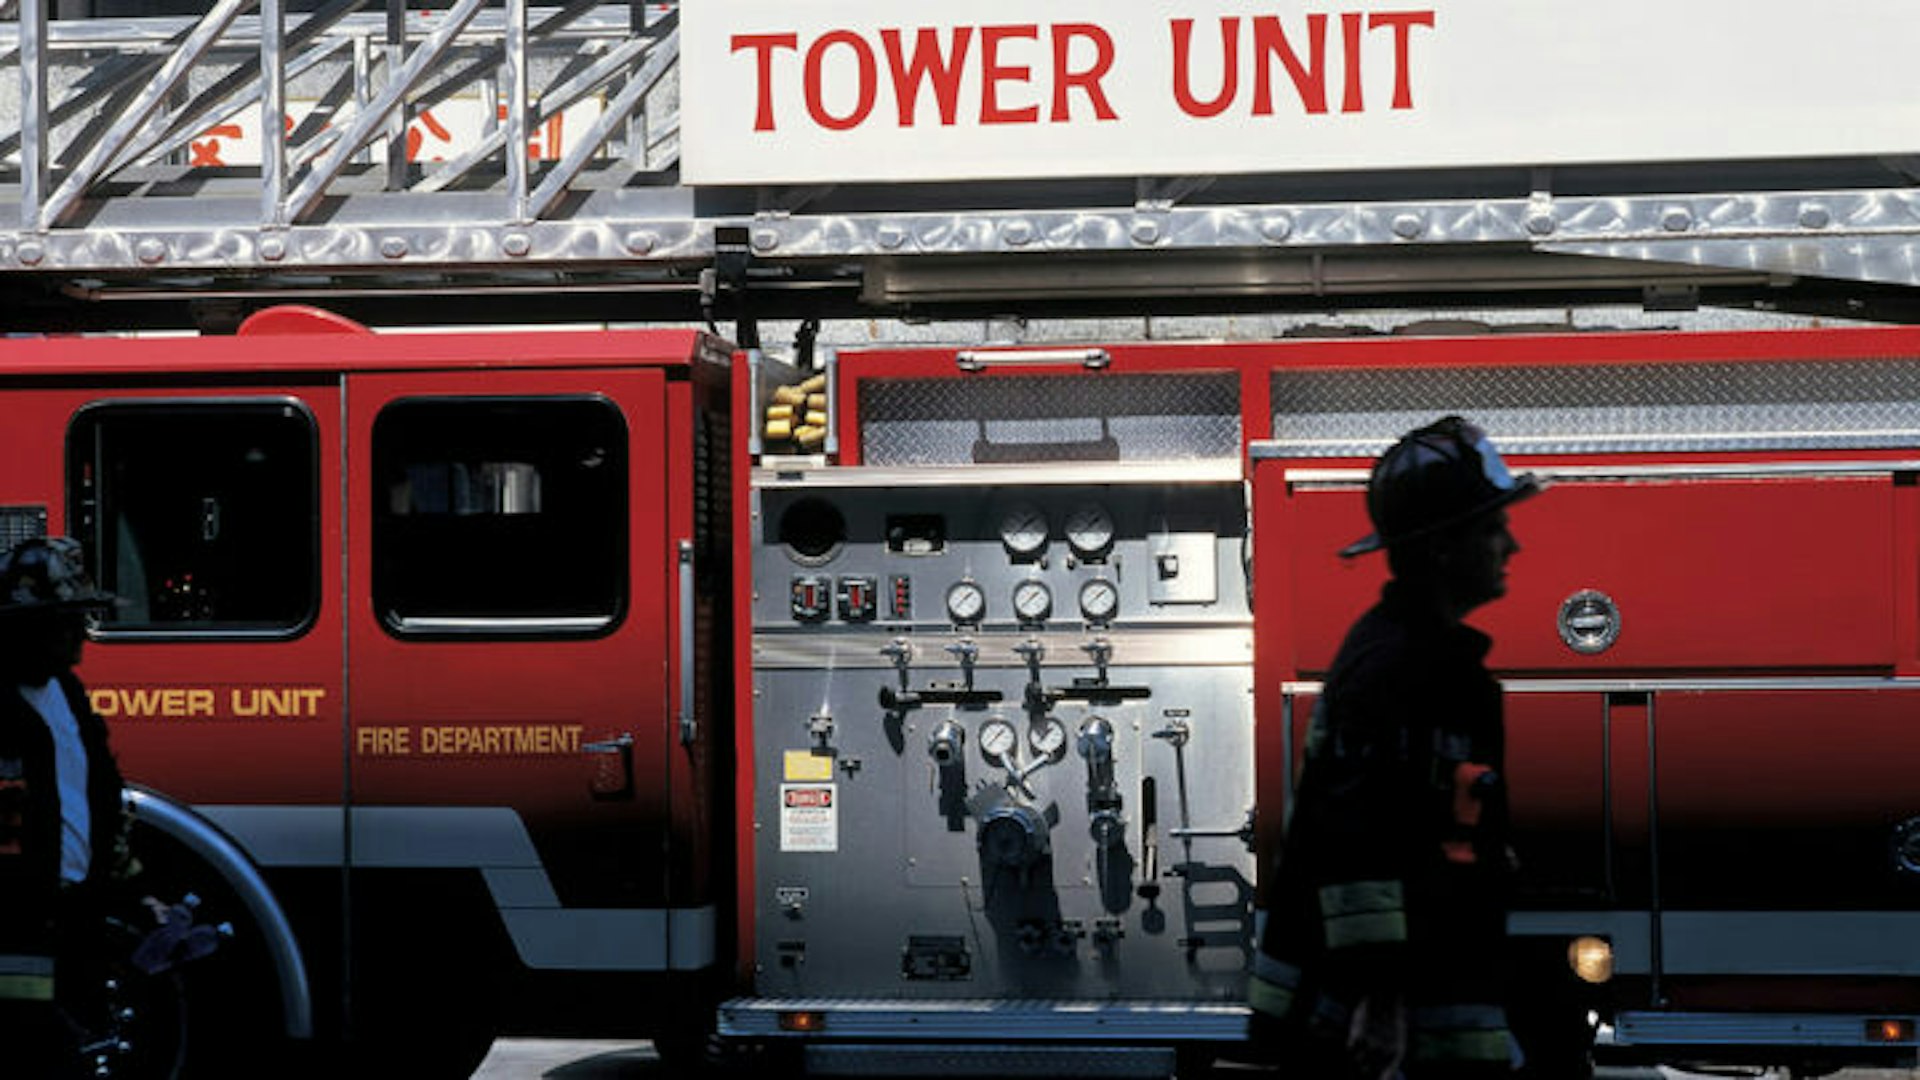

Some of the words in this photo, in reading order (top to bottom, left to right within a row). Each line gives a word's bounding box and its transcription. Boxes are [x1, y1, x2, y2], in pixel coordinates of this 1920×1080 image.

[730, 23, 1118, 133] TOWER
[1170, 10, 1436, 117] UNIT
[85, 688, 214, 717] OWER
[231, 688, 325, 717] UNIT
[356, 726, 410, 754] FIRE
[420, 725, 583, 754] DEPARTMENT
